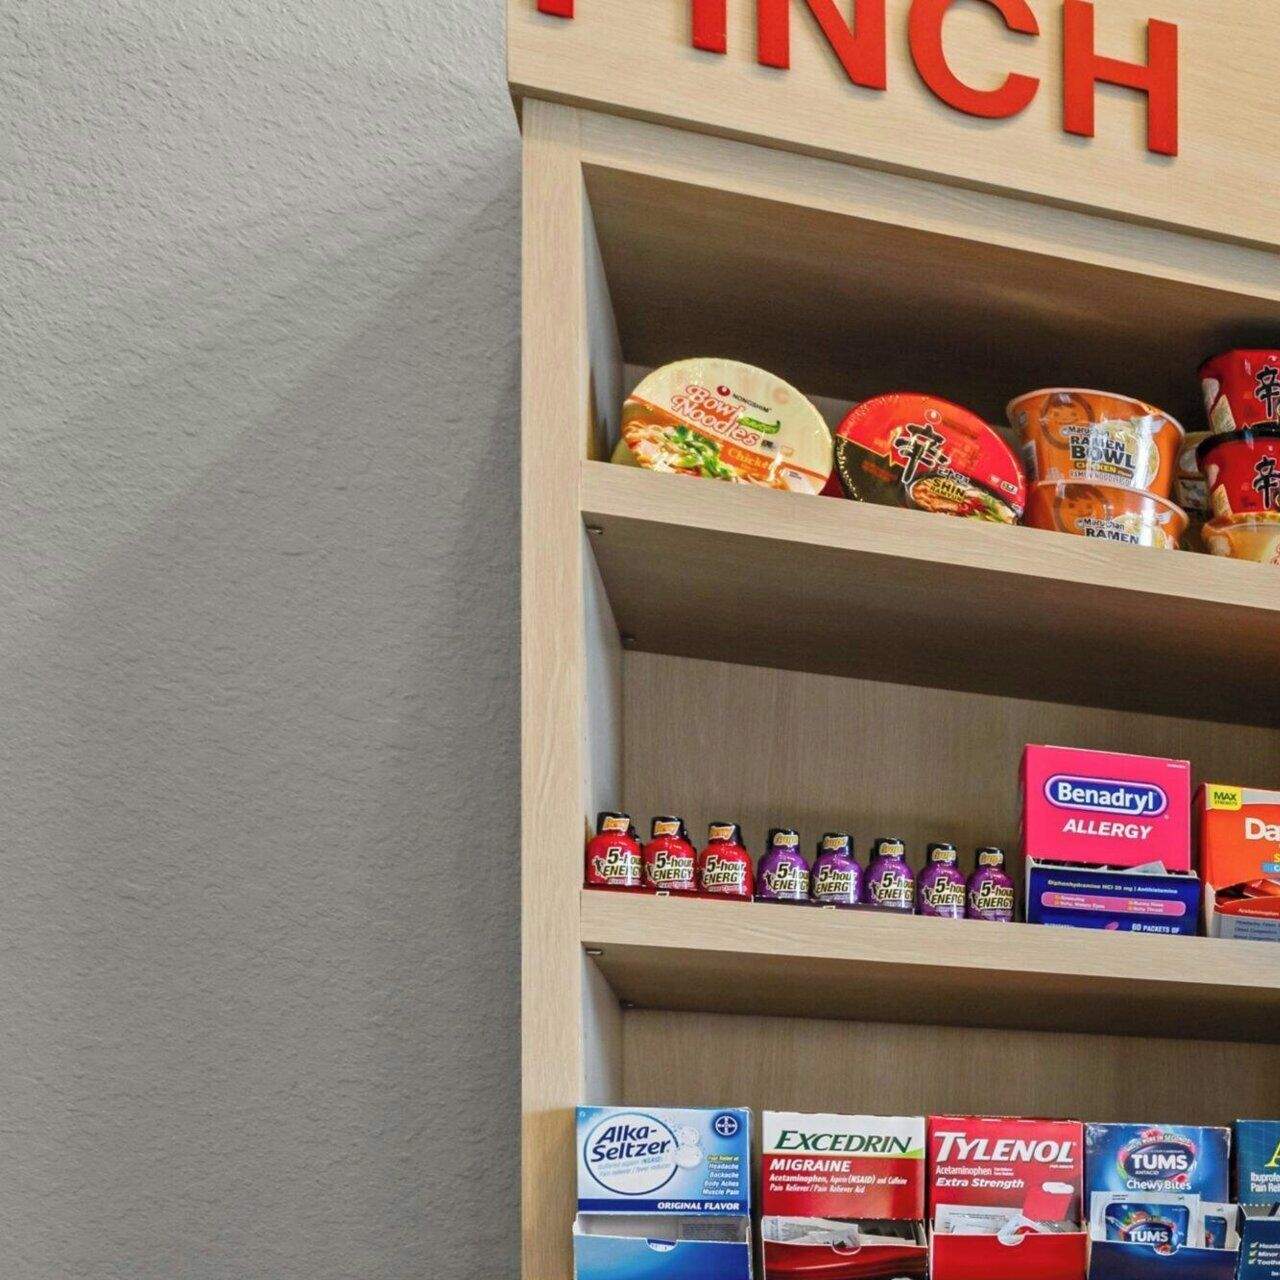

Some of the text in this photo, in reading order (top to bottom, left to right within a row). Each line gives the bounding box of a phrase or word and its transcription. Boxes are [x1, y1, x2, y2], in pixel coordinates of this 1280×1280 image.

[537, 0, 1178, 156] NCH
[686, 384, 746, 419] Bowl
[671, 395, 761, 446] Noodles
[1070, 436, 1125, 450] RAMEN
[893, 423, 951, 484] 辛
[1071, 445, 1136, 469] BOWL
[932, 478, 965, 496] SHIN
[1086, 528, 1140, 544] RAMEN
[1057, 782, 1154, 813] Benadryl
[1214, 791, 1237, 802] MAX
[1062, 818, 1153, 840] ALLERGY
[654, 867, 693, 880] ENERGY
[596, 1124, 657, 1145] Alka-
[774, 1129, 912, 1154] EXCEDRIN
[590, 1139, 671, 1163] Seltzer
[933, 1131, 1074, 1163] TYLENOL
[769, 1158, 852, 1173] MIGRAINE
[1130, 1154, 1188, 1171] TUMS
[709, 1171, 739, 1179] Backache
[769, 1173, 828, 1184] Acetaminophen,
[848, 1174, 876, 1185] (NSAID)
[935, 1166, 992, 1177] Acetaminophen
[935, 1177, 1025, 1190] Extra Strength
[1126, 1178, 1193, 1191] Chewy Bites
[657, 1201, 740, 1211] ORIGINAL FLAVOR
[1129, 1230, 1169, 1243] TUMS
